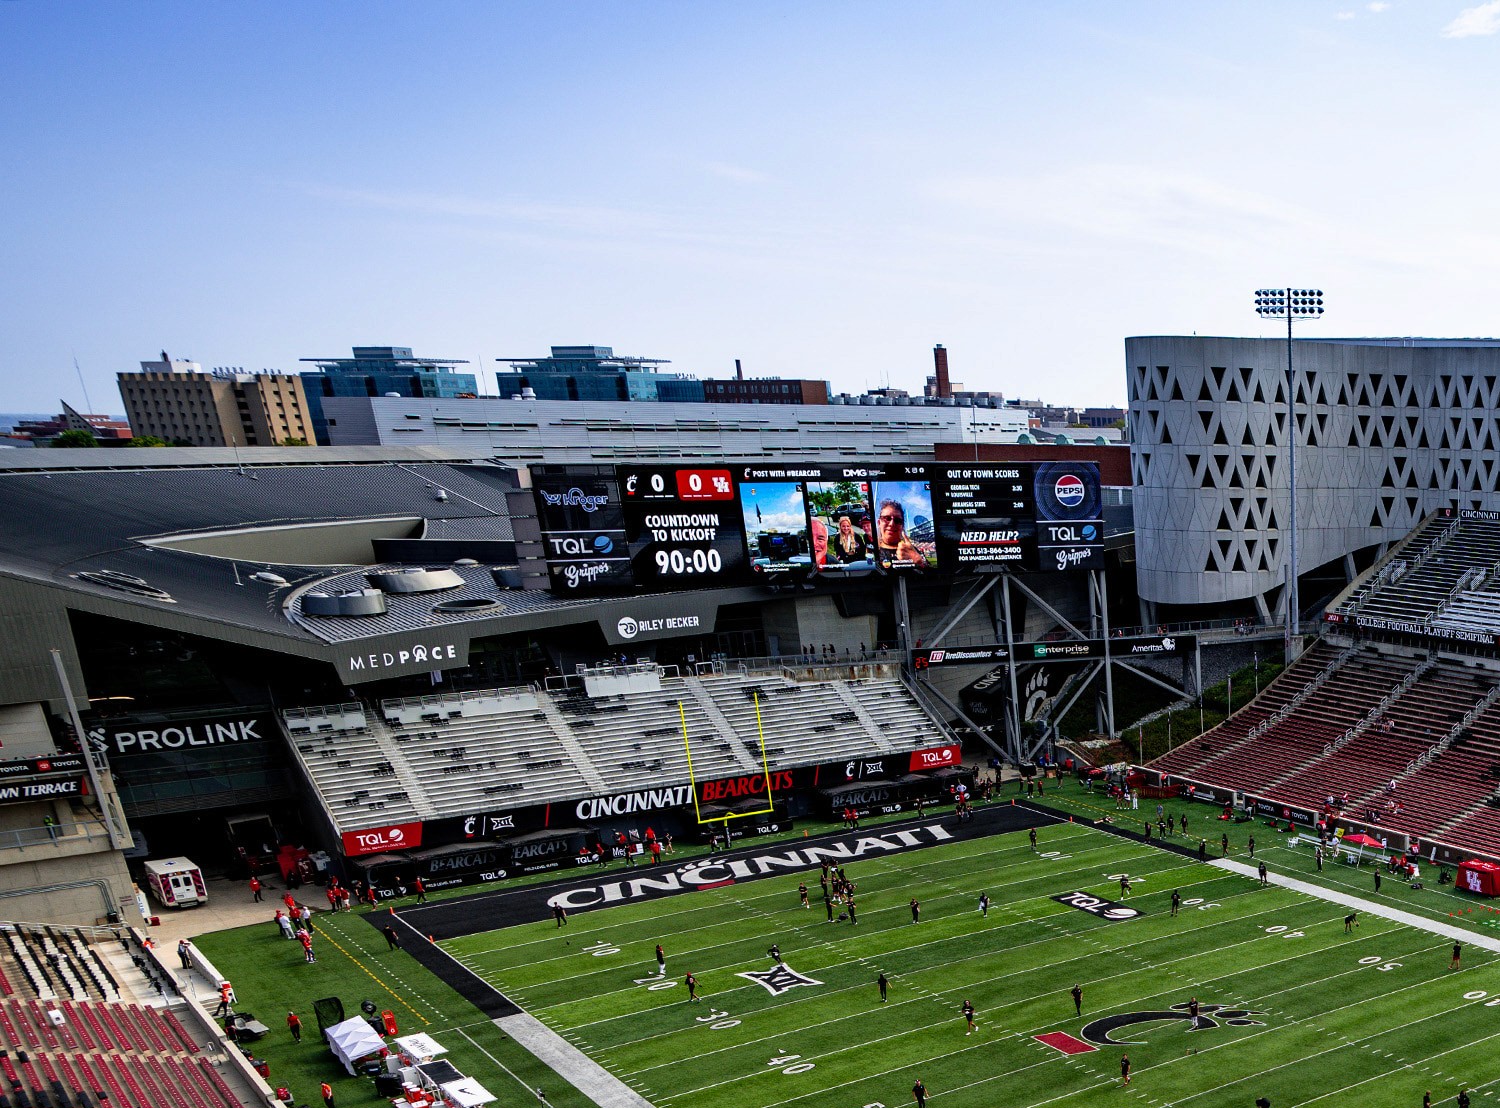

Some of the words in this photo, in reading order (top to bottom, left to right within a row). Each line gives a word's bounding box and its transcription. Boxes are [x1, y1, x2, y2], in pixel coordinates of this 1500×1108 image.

[786, 469, 821, 477] #BEARCATS
[843, 469, 867, 477] DMG
[947, 470, 961, 478] OUT
[963, 470, 972, 478] OF
[973, 470, 993, 478] TOWN
[995, 470, 1019, 478] SCORES
[651, 474, 665, 492] 0
[689, 474, 702, 492] 0
[1057, 487, 1083, 495] PEPSI
[563, 487, 609, 513] Kroger
[645, 514, 719, 528] COUNTDOWN
[1461, 510, 1499, 520] CINCINNATI
[652, 529, 667, 542] TO
[671, 528, 716, 542] KICKOFF
[960, 532, 987, 542] NEED
[989, 531, 1019, 542] HELP?
[1048, 527, 1080, 541] TQL
[551, 538, 593, 554] TQL
[977, 547, 1021, 555] 513-866-3400
[655, 549, 721, 574] 90:00
[1056, 548, 1091, 570] Grippo's
[564, 562, 609, 588] Grippo's
[639, 618, 665, 632] RILEY
[667, 616, 699, 630] DECKER
[1356, 617, 1386, 629] COLLEGE
[1387, 620, 1423, 634] FOOTBALL
[1424, 626, 1455, 639] PLAYOFF
[1456, 631, 1495, 644] SEMIFINAL
[1037, 644, 1089, 654] enterprise
[1132, 643, 1163, 653] Ameritas
[350, 645, 456, 670] MEDPACE
[915, 656, 928, 669] 25
[115, 719, 262, 753] PROLINK
[52, 759, 82, 768] TOYOTA
[921, 752, 942, 763] TQL
[0, 765, 29, 773] TOYOTA
[22, 780, 78, 797] TERRACE
[702, 770, 793, 802] BEARCATS
[576, 784, 693, 820] CINCINNATI
[832, 789, 889, 808] BEARCATS
[881, 804, 896, 813] TQL
[756, 825, 772, 834] TQL
[356, 832, 389, 847] TQL
[547, 824, 955, 909] CINCINNATI
[575, 856, 592, 864] TQL
[480, 871, 498, 881] TQL
[378, 888, 394, 898] TQL
[1061, 891, 1109, 914] TQL
